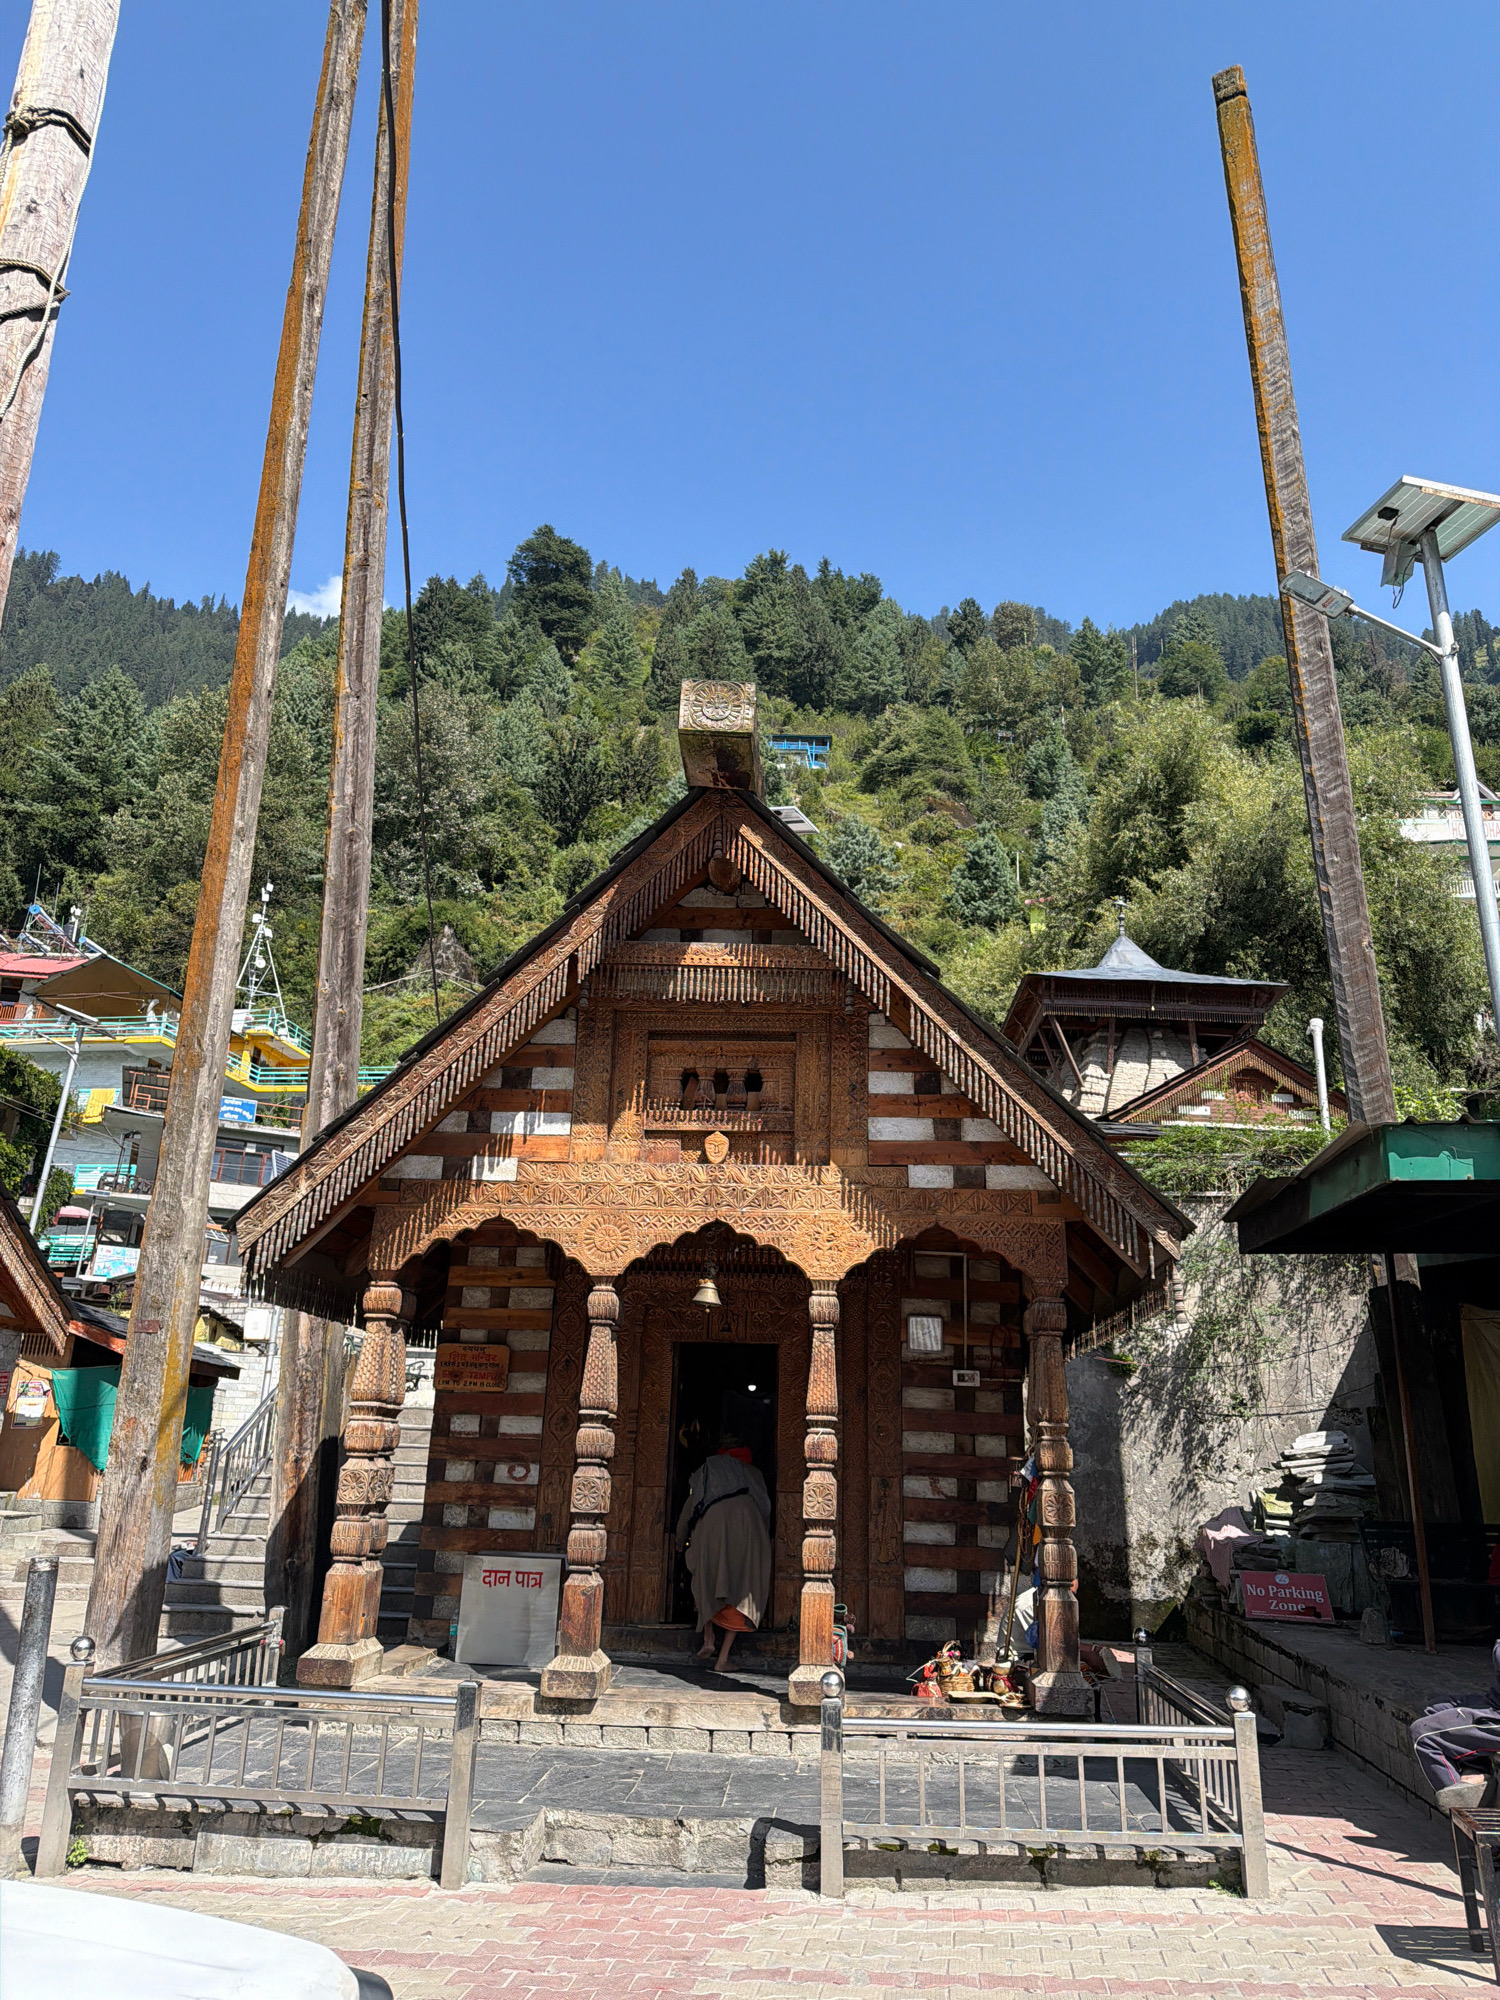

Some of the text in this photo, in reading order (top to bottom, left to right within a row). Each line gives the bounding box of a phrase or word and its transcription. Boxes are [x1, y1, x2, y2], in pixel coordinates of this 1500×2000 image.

[482, 1569, 543, 1589] दान पात्र
[1246, 1584, 1324, 1603] No Parking
[1268, 1600, 1306, 1612] Zone
